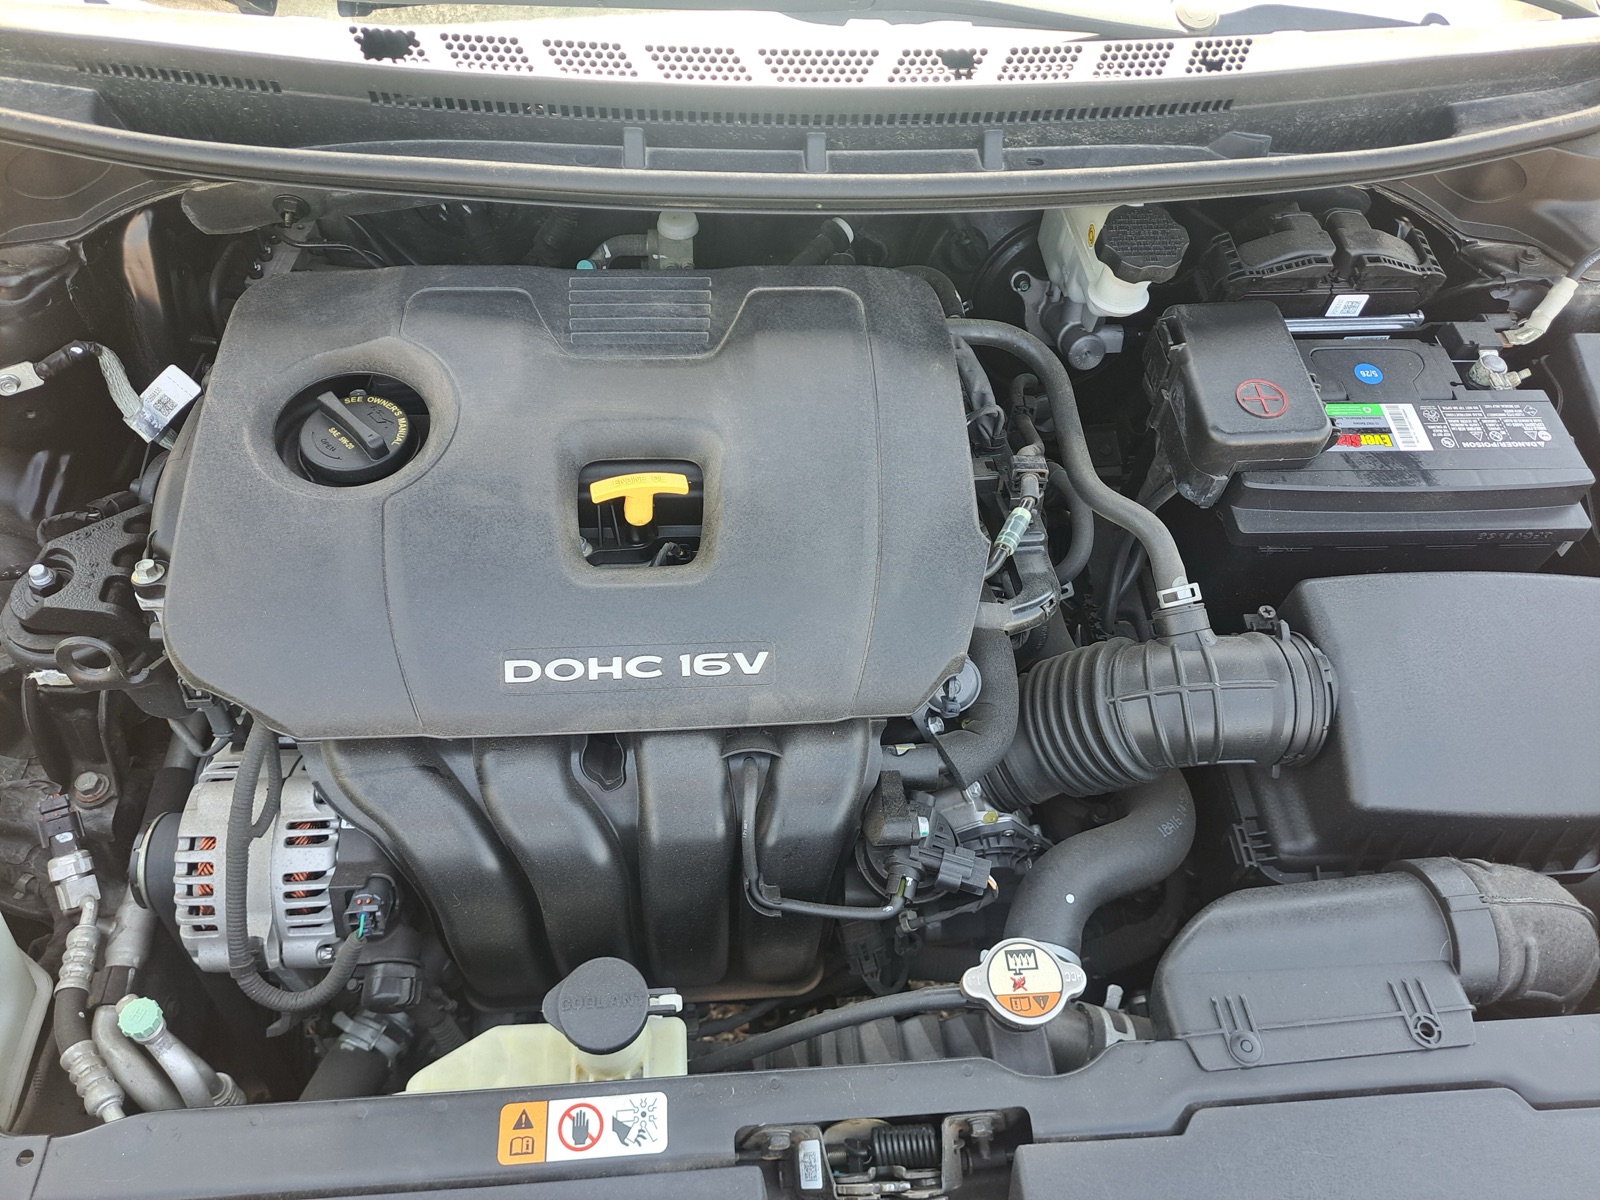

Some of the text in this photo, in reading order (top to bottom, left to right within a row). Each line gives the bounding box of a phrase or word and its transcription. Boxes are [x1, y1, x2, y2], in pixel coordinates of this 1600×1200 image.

[1360, 370, 1379, 378] 5/26
[344, 396, 407, 446] SEE OWNER'S MANUAL
[328, 427, 341, 438] SAE
[320, 438, 337, 452] OPEN
[1336, 434, 1393, 448] EverSta
[612, 475, 647, 487] ENGINE
[504, 651, 769, 684] DOHC 16V
[1065, 972, 1083, 982] HCC
[561, 994, 645, 1011] COOLANT
